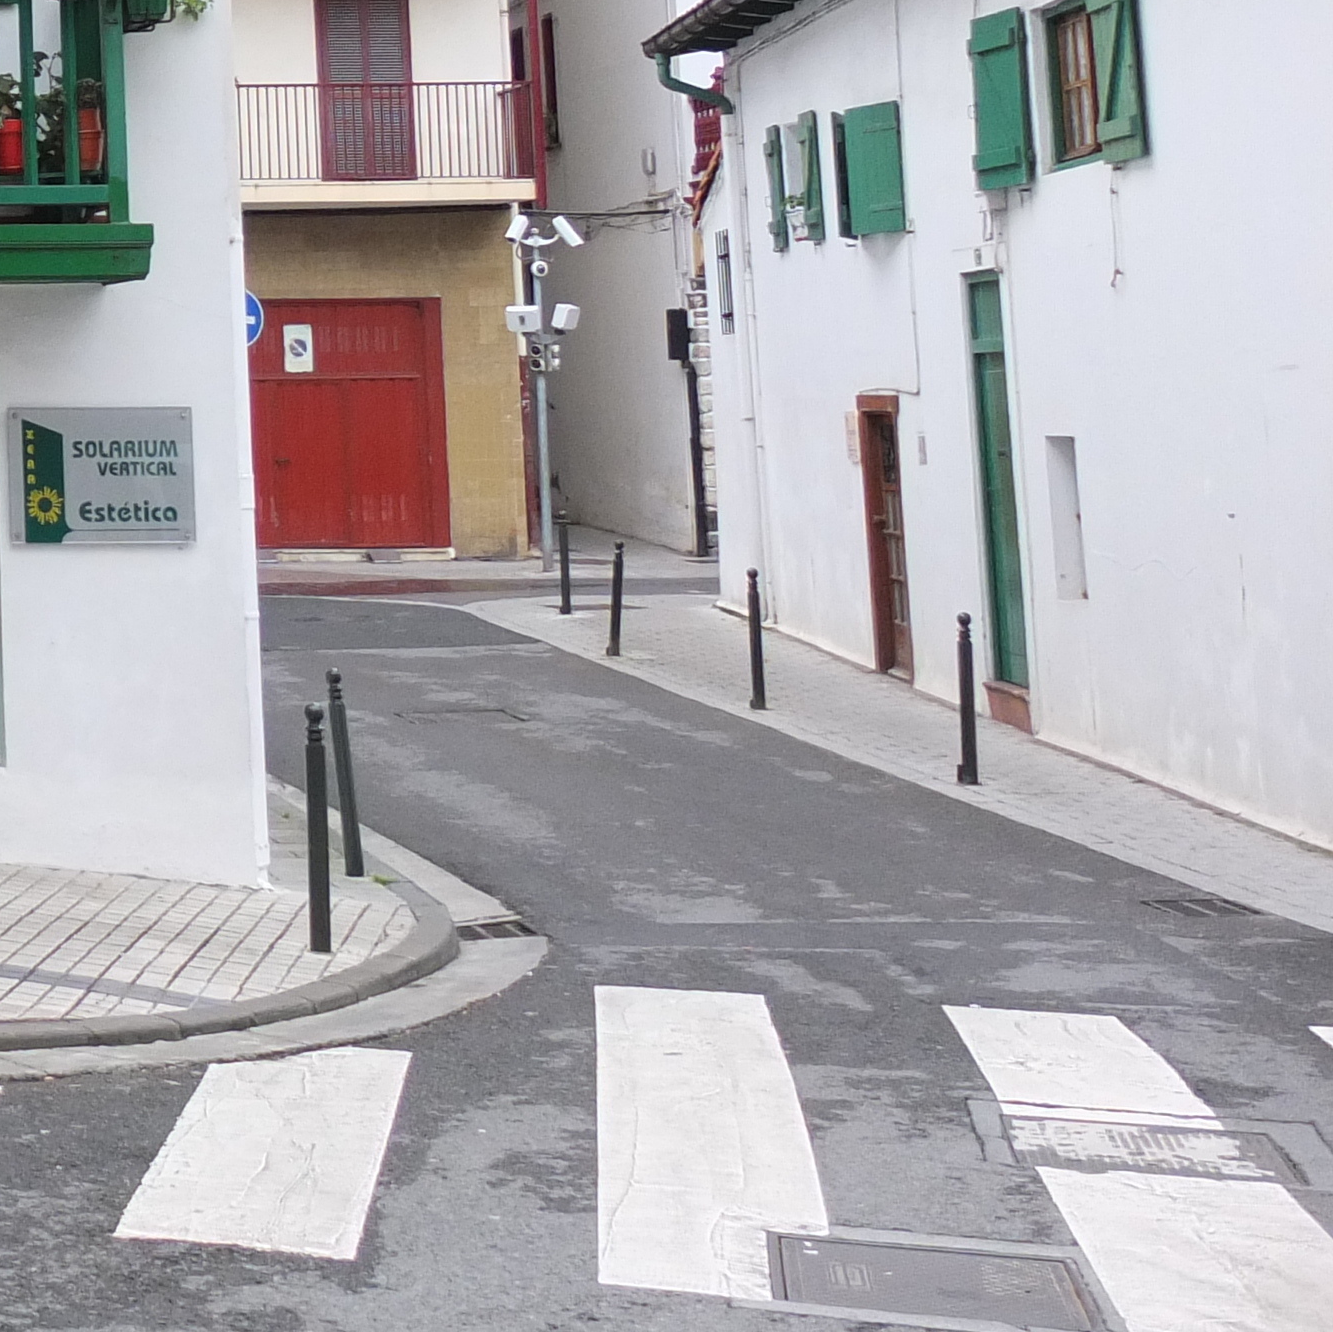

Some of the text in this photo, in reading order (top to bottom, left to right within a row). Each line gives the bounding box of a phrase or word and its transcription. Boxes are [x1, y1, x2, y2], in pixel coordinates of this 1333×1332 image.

[71, 439, 179, 459] SOLARIUM
[96, 461, 177, 477] VERTICAL
[78, 500, 179, 523] Estética
